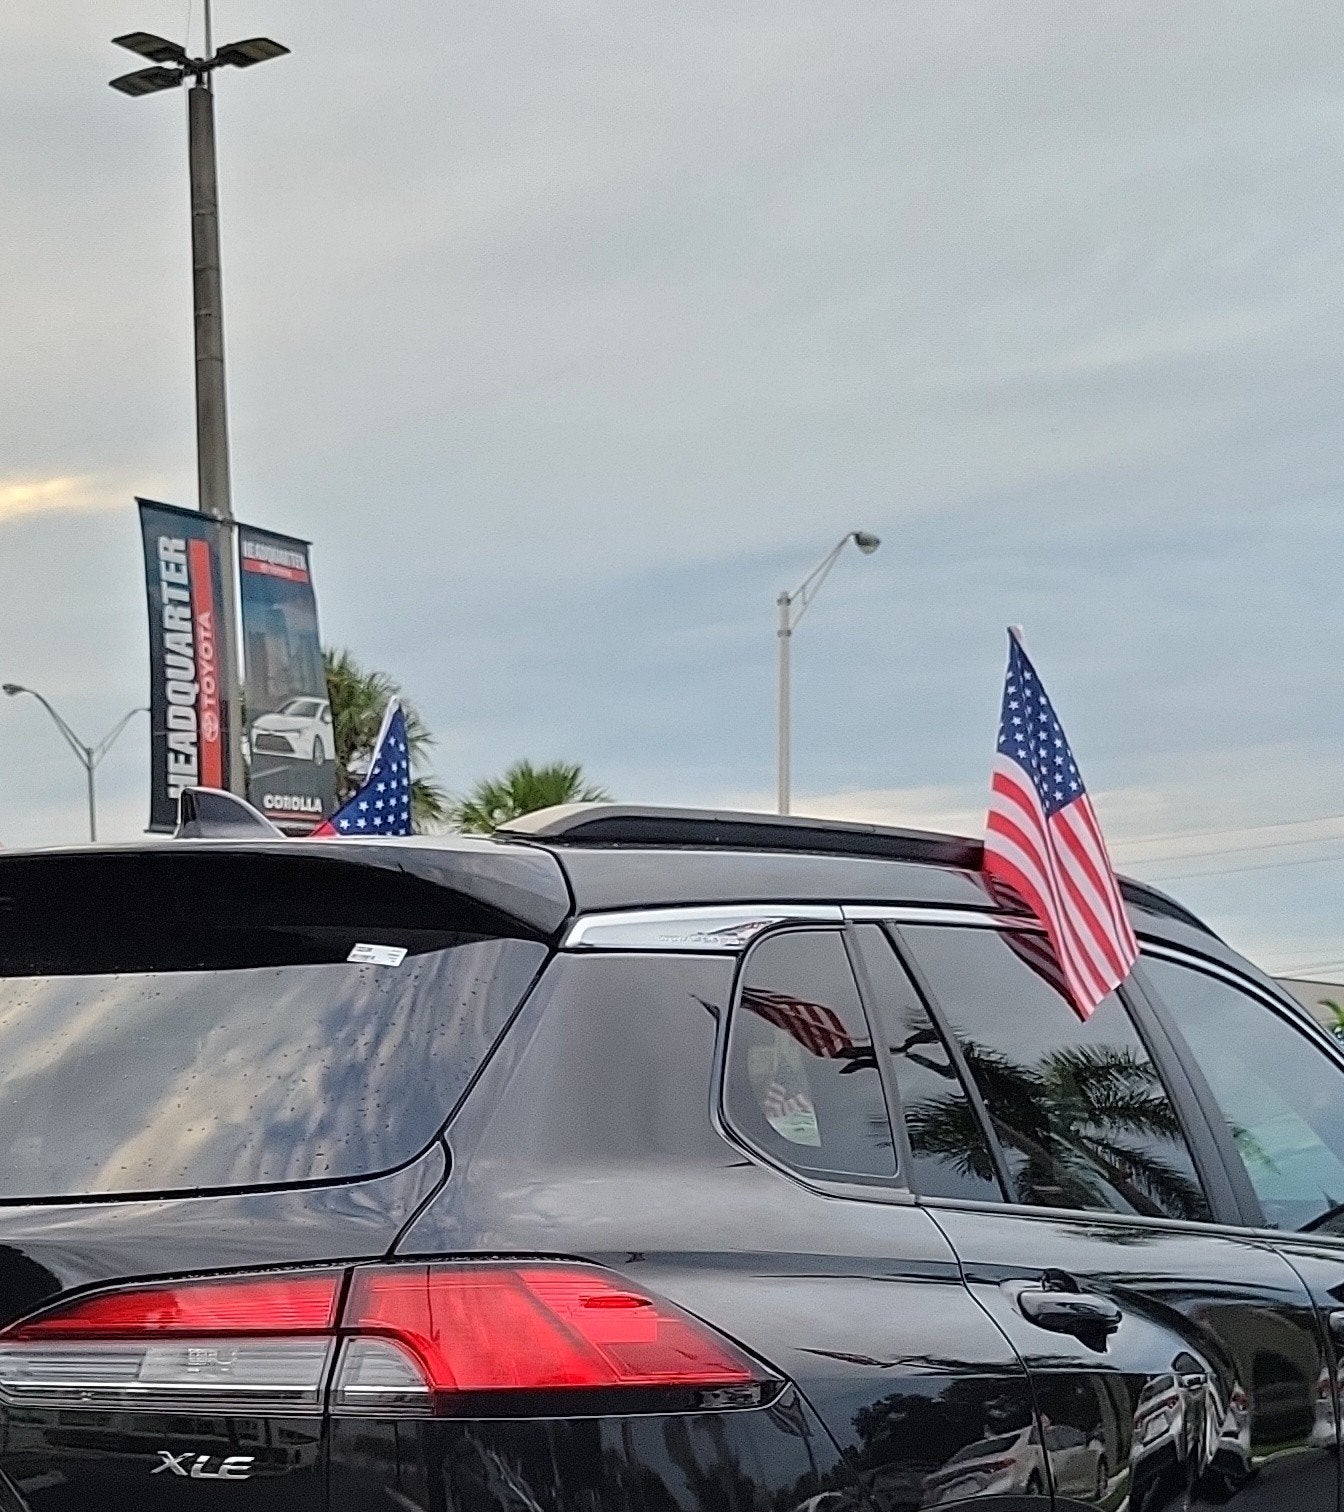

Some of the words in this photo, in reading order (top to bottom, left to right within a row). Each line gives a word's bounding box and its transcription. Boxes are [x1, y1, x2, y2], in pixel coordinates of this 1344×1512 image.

[158, 536, 200, 799] HEADQUARTER
[197, 612, 216, 707] TOYOTA
[263, 794, 323, 813] COROLLA
[150, 1450, 256, 1480] XLE
